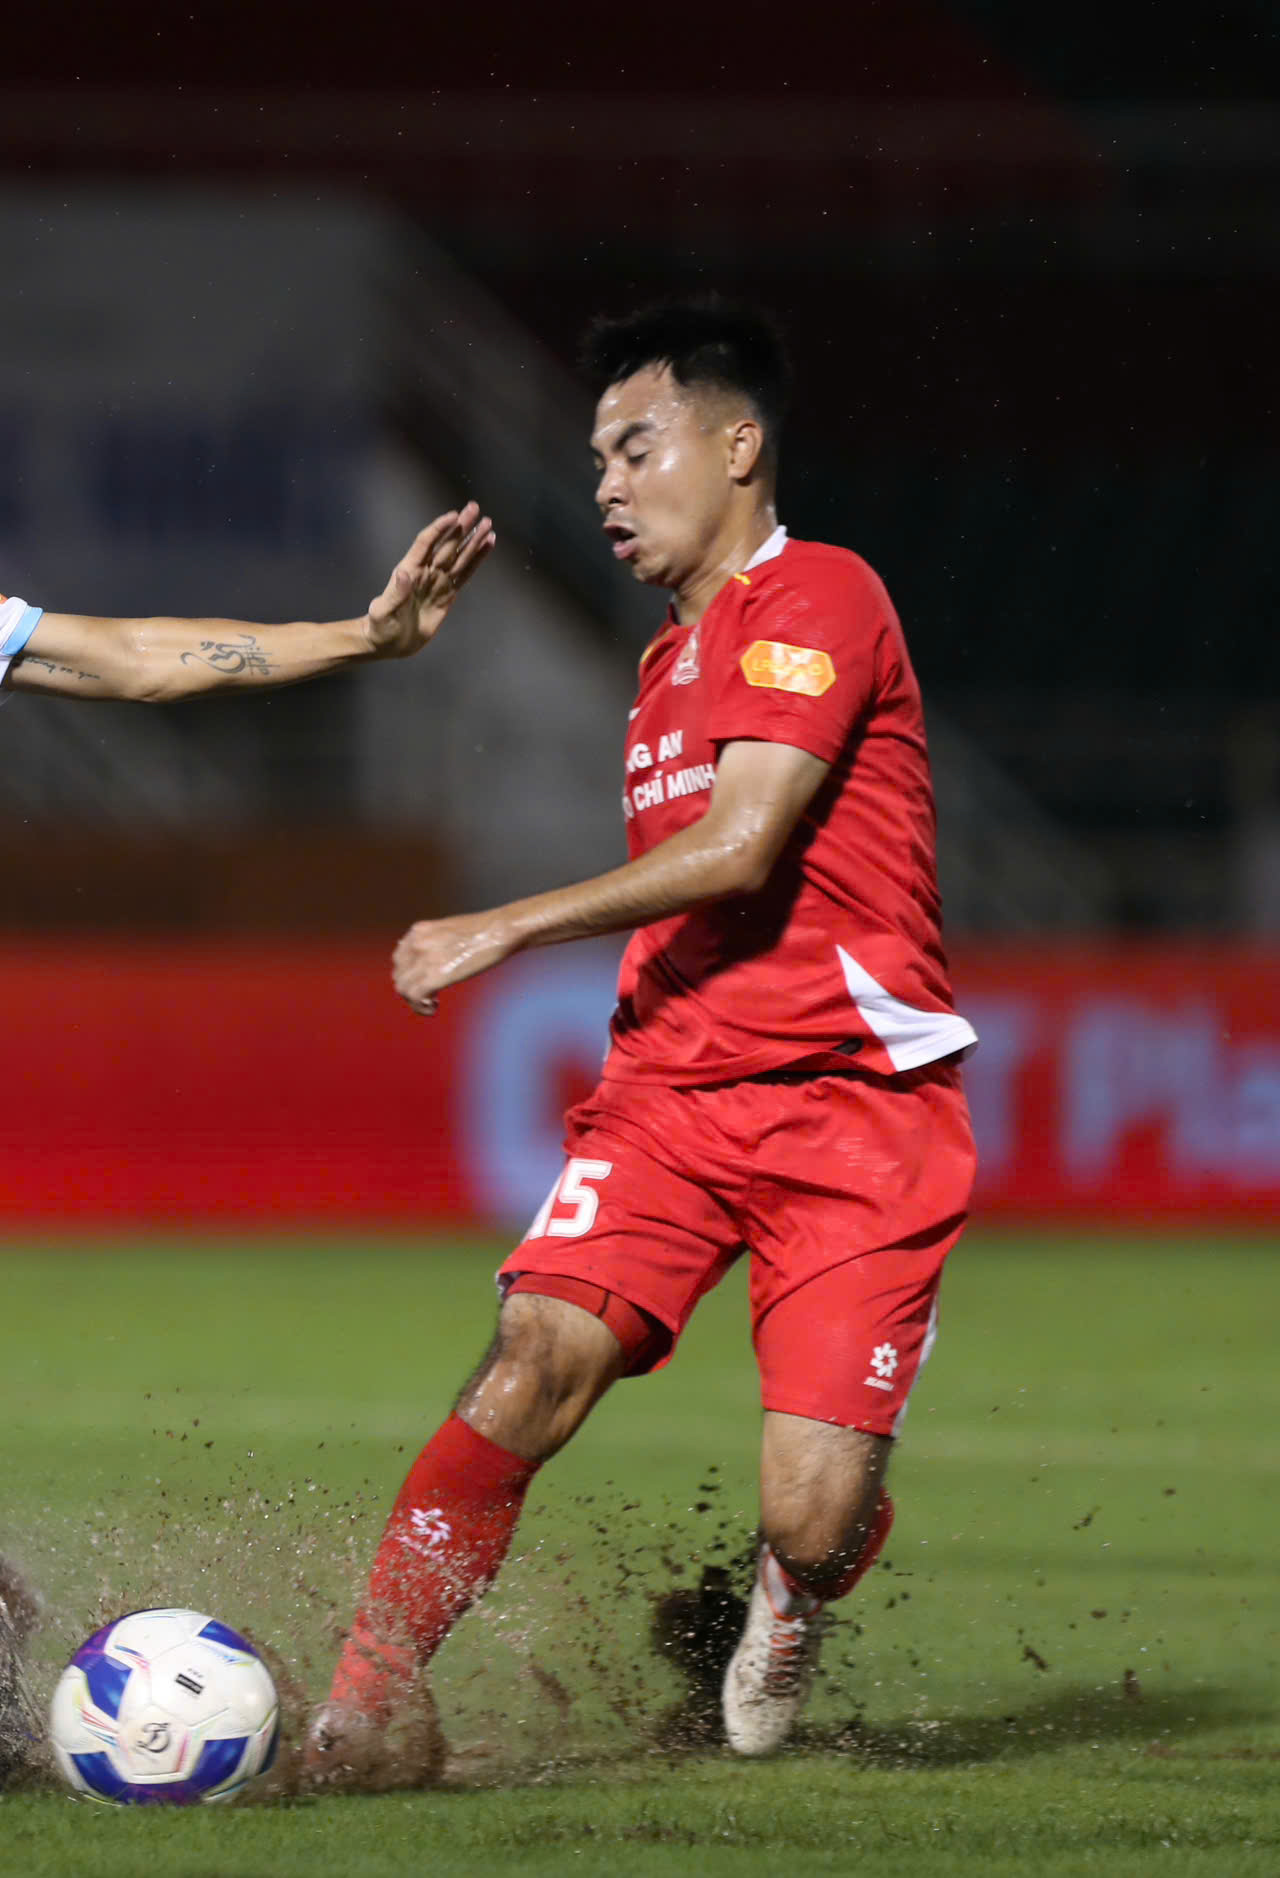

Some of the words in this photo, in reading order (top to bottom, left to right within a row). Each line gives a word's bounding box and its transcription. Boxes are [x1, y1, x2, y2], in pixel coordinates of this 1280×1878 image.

[658, 729, 683, 762] AN
[632, 770, 665, 811] CHÍ
[666, 763, 716, 800] MINH
